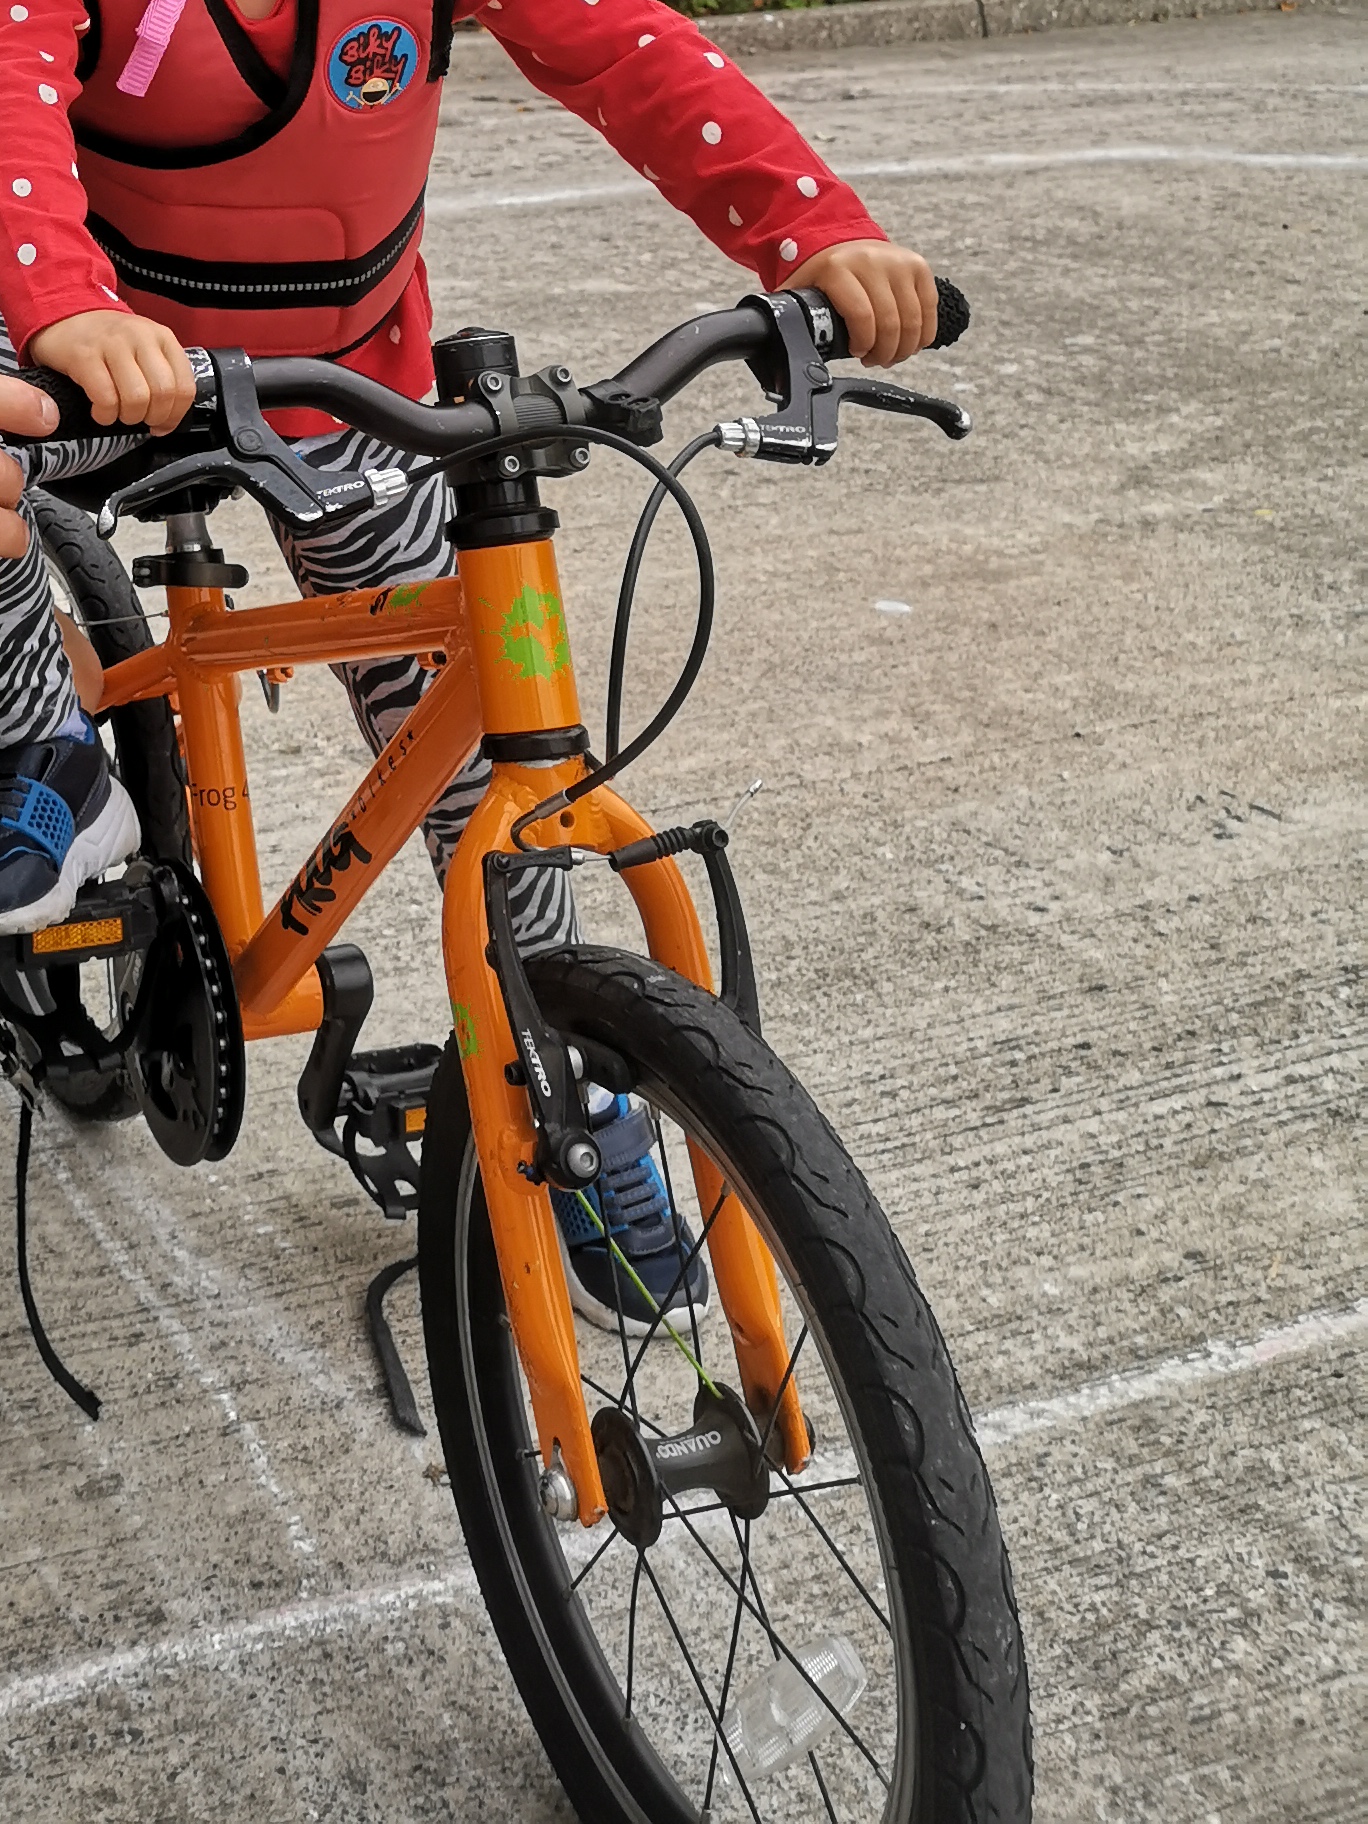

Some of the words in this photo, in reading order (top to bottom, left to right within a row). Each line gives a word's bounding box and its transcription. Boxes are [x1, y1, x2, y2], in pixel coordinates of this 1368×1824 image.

[316, 480, 366, 500] TEKTRO
[521, 1028, 552, 1097] TEKTRO
[657, 1430, 722, 1459] QUANDO
